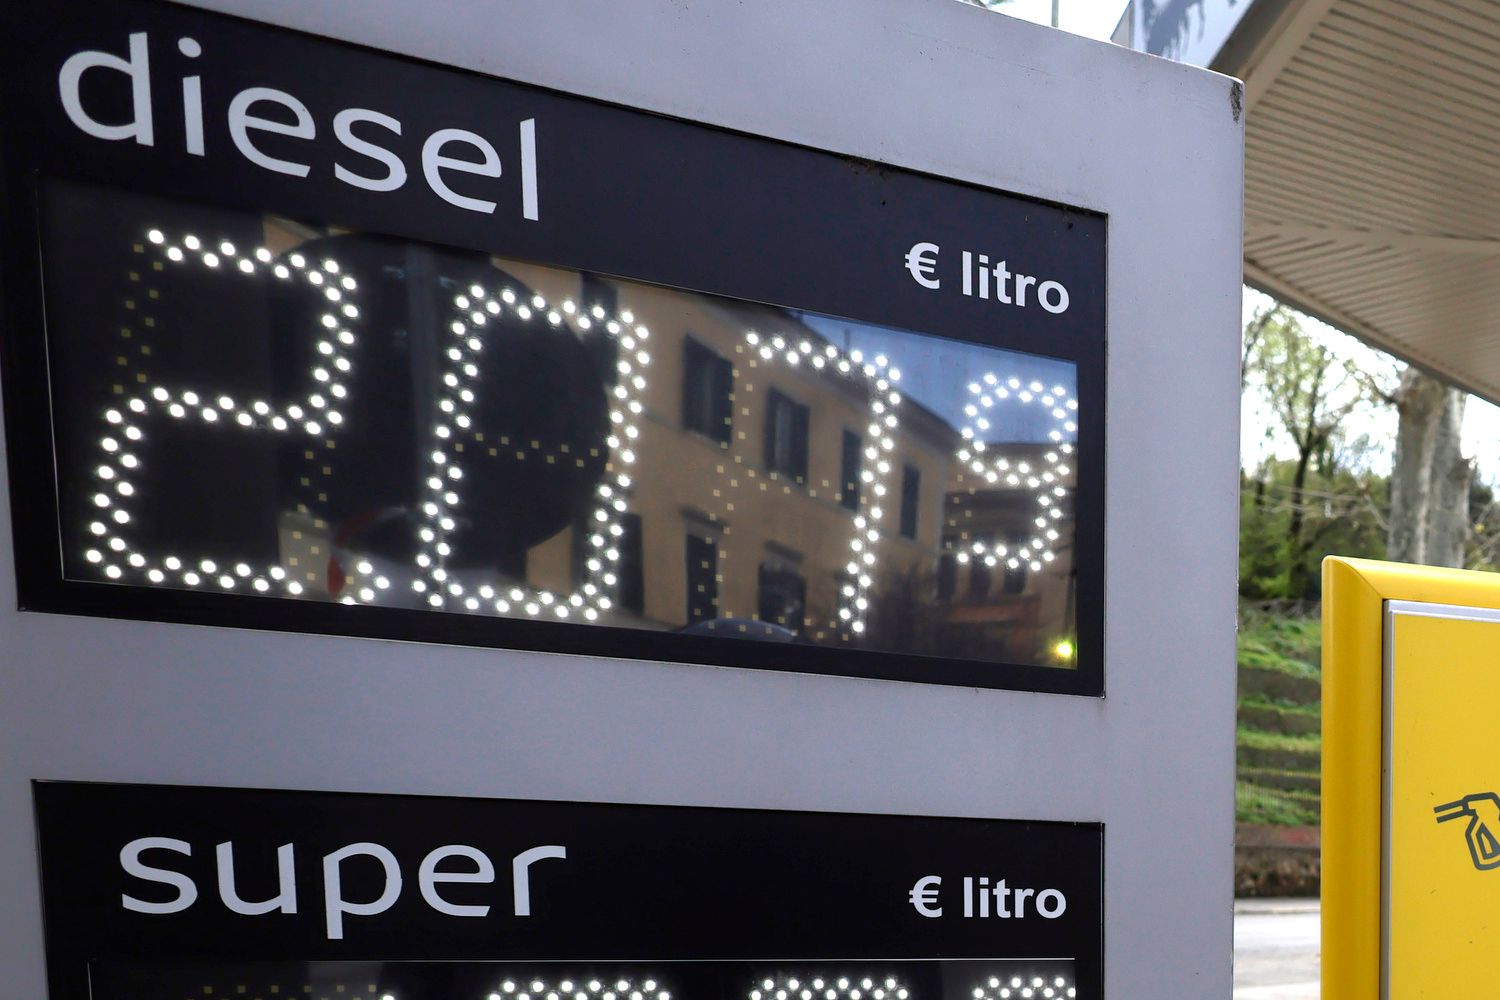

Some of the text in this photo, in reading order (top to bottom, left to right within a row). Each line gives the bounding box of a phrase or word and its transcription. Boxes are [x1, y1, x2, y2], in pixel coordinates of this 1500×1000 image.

[58, 32, 541, 222] diesel
[905, 243, 1070, 314] € litro
[120, 837, 567, 940] super
[908, 875, 1067, 919] € litro
